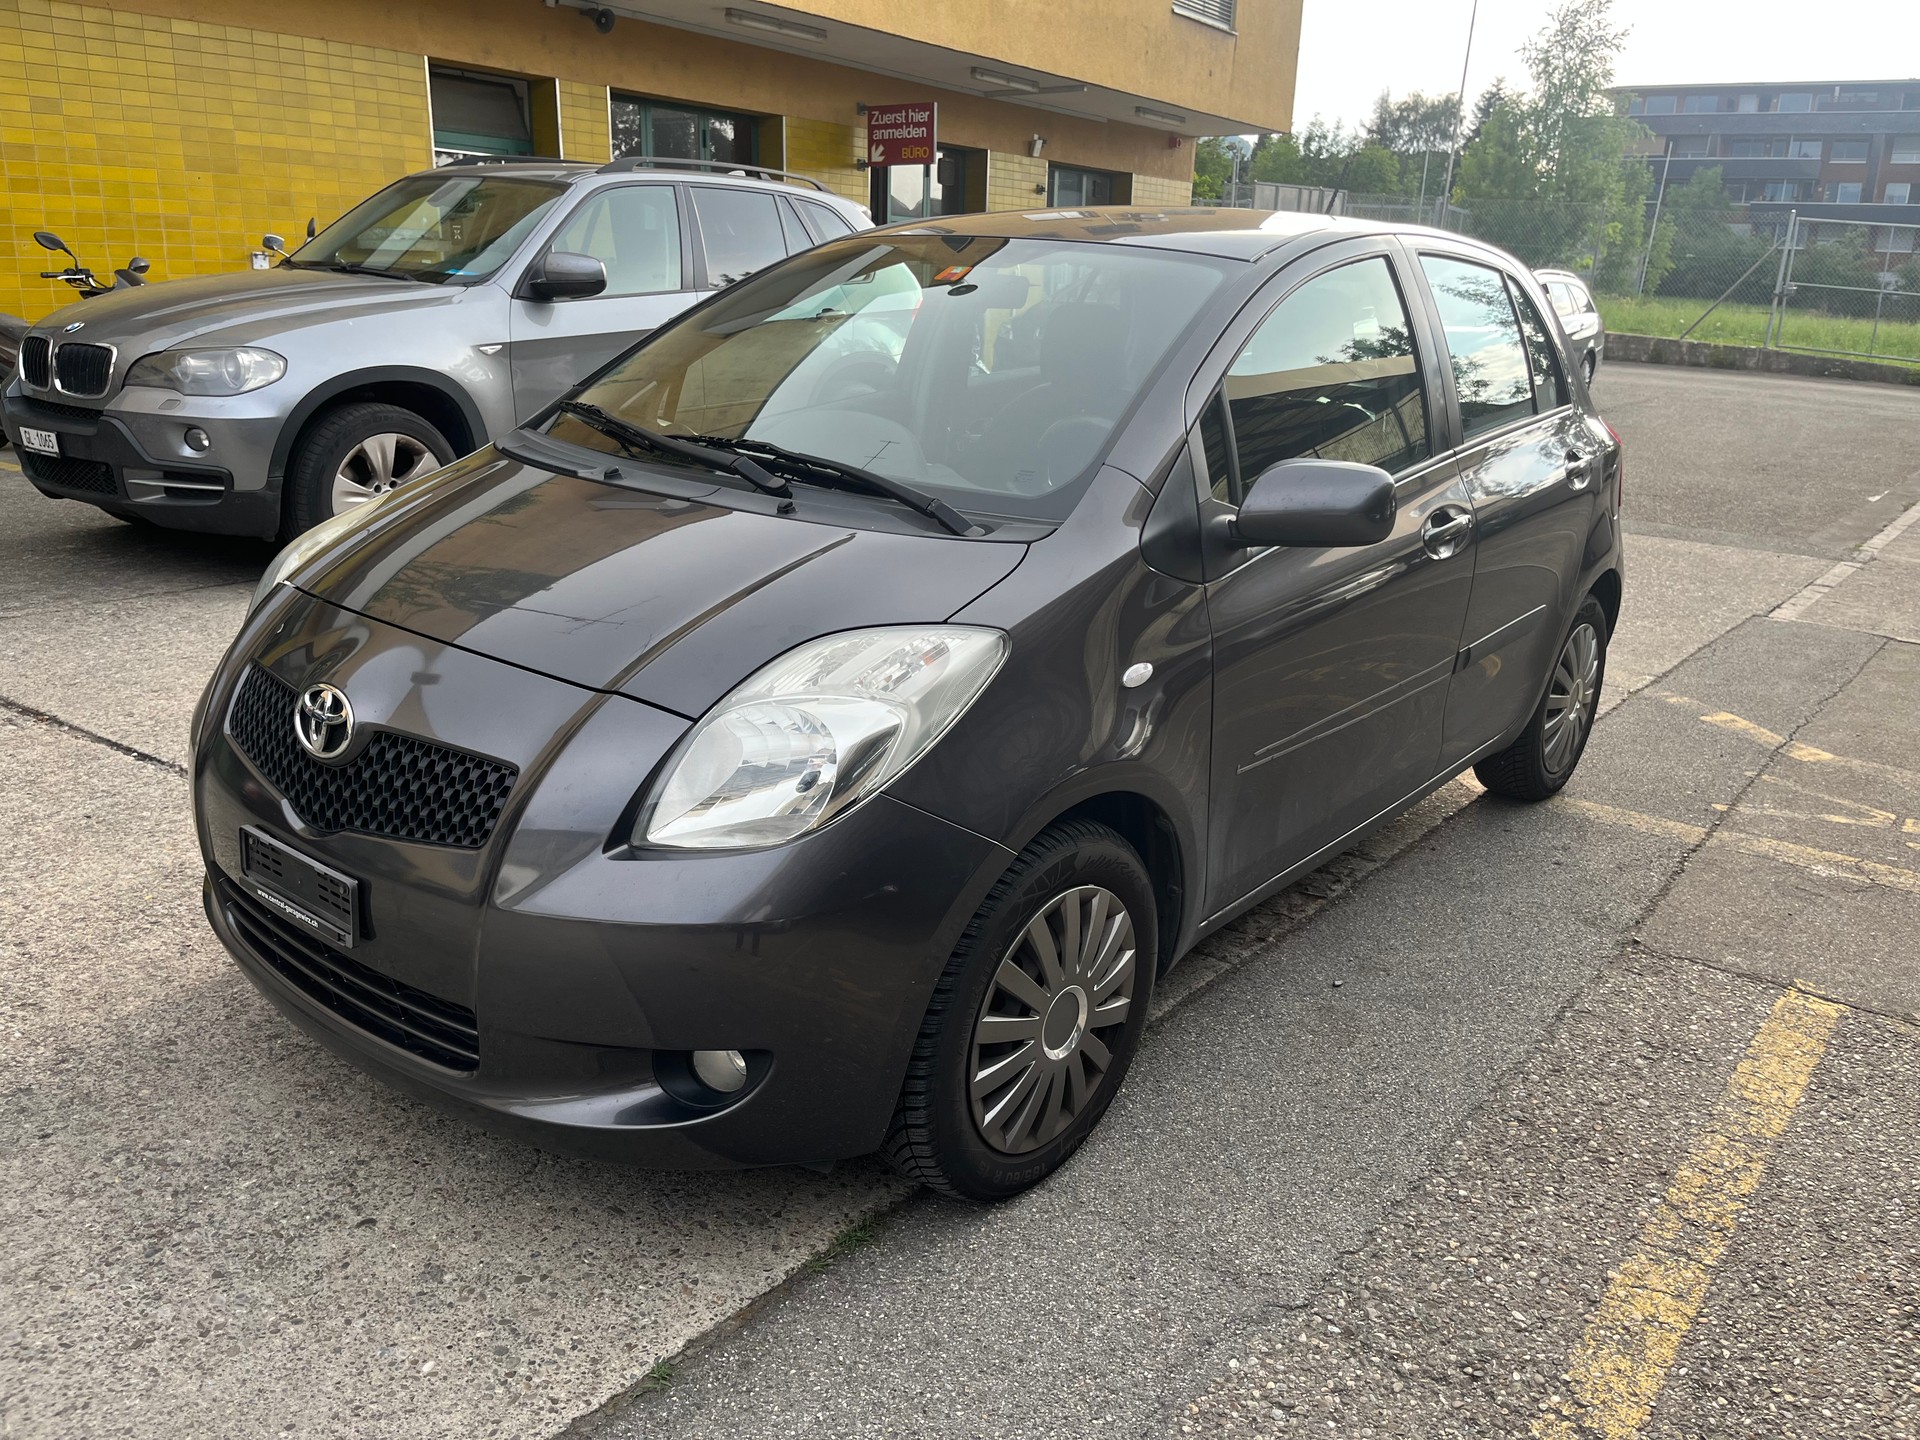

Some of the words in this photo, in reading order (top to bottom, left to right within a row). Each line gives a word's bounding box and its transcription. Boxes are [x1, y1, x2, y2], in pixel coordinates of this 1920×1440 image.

[871, 109, 906, 125] Zuerst
[908, 108, 930, 123] hier
[872, 124, 927, 140] anmelden
[901, 144, 930, 159] BÜRO
